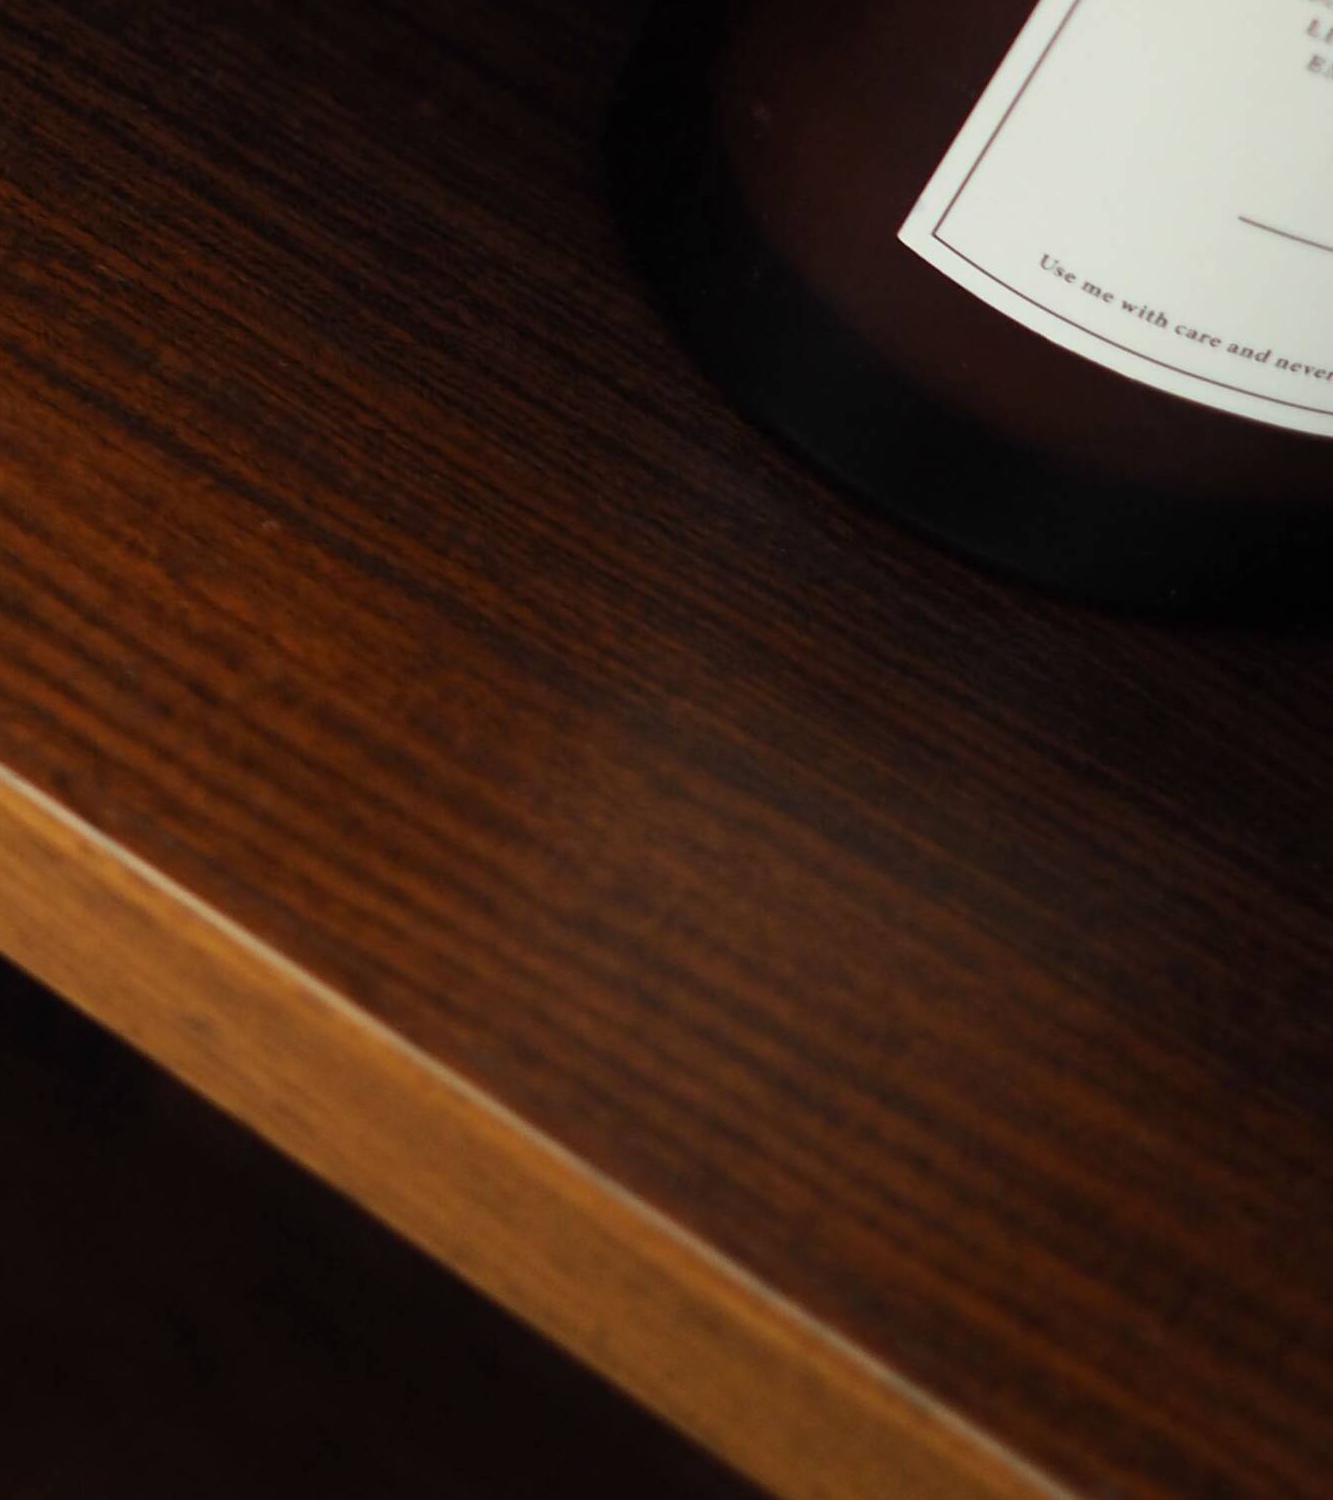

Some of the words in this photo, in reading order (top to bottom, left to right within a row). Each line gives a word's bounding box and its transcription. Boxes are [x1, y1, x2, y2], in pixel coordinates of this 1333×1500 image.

[1039, 253, 1077, 284] Use
[1080, 280, 1115, 304] me
[1120, 299, 1169, 329] with
[1174, 323, 1222, 348] care
[1226, 342, 1272, 364] and
